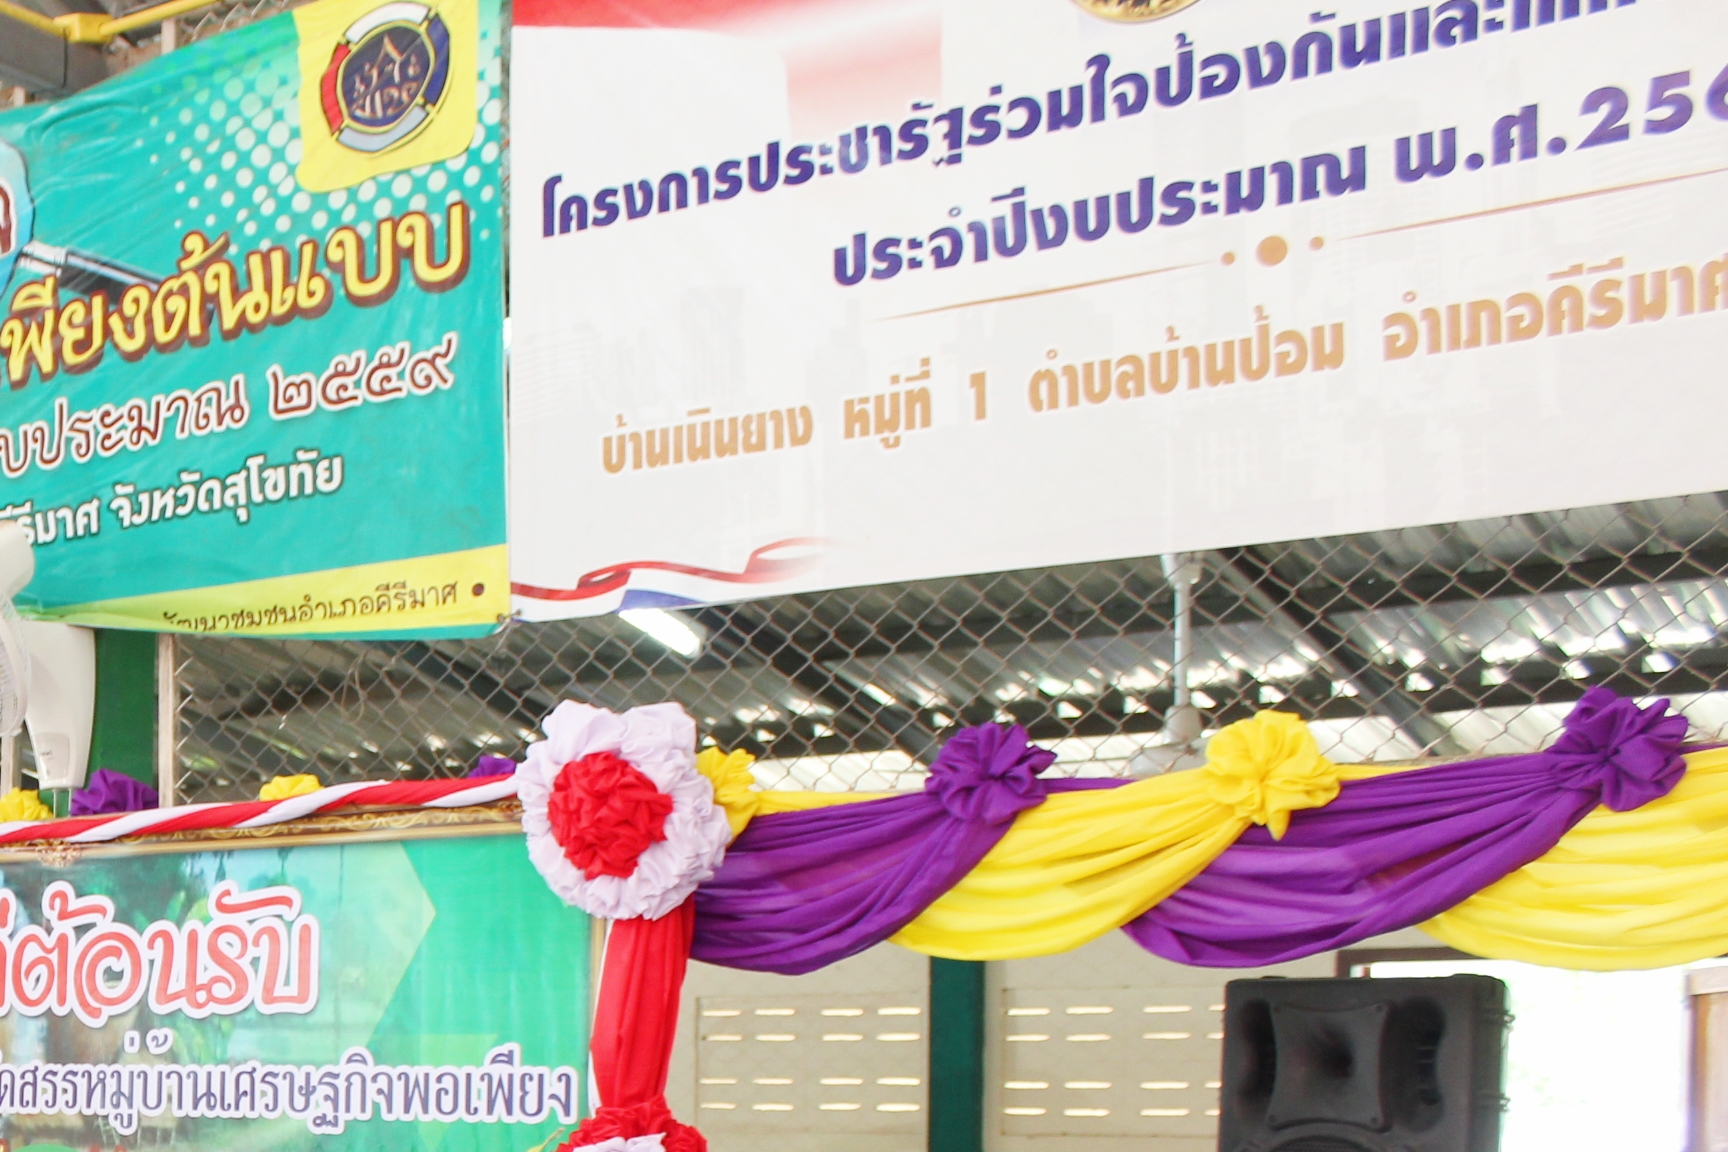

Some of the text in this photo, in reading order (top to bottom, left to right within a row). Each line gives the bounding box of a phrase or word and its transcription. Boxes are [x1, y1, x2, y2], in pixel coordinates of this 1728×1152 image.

[542, 0, 1636, 238] โครงการประชารัฐร่วมใจป้องกันและแ
[832, 144, 1368, 287] ประจำปีงบประมาณ
[268, 332, 459, 423] ๒๕๕๙
[601, 405, 814, 475] บ้านเนินยาง
[844, 358, 933, 449] หมู่ที่
[969, 372, 988, 421] 1
[1029, 305, 1344, 413] ตำบลบ้านป้อม
[108, 448, 345, 531] จังหวัดสุโขทัย
